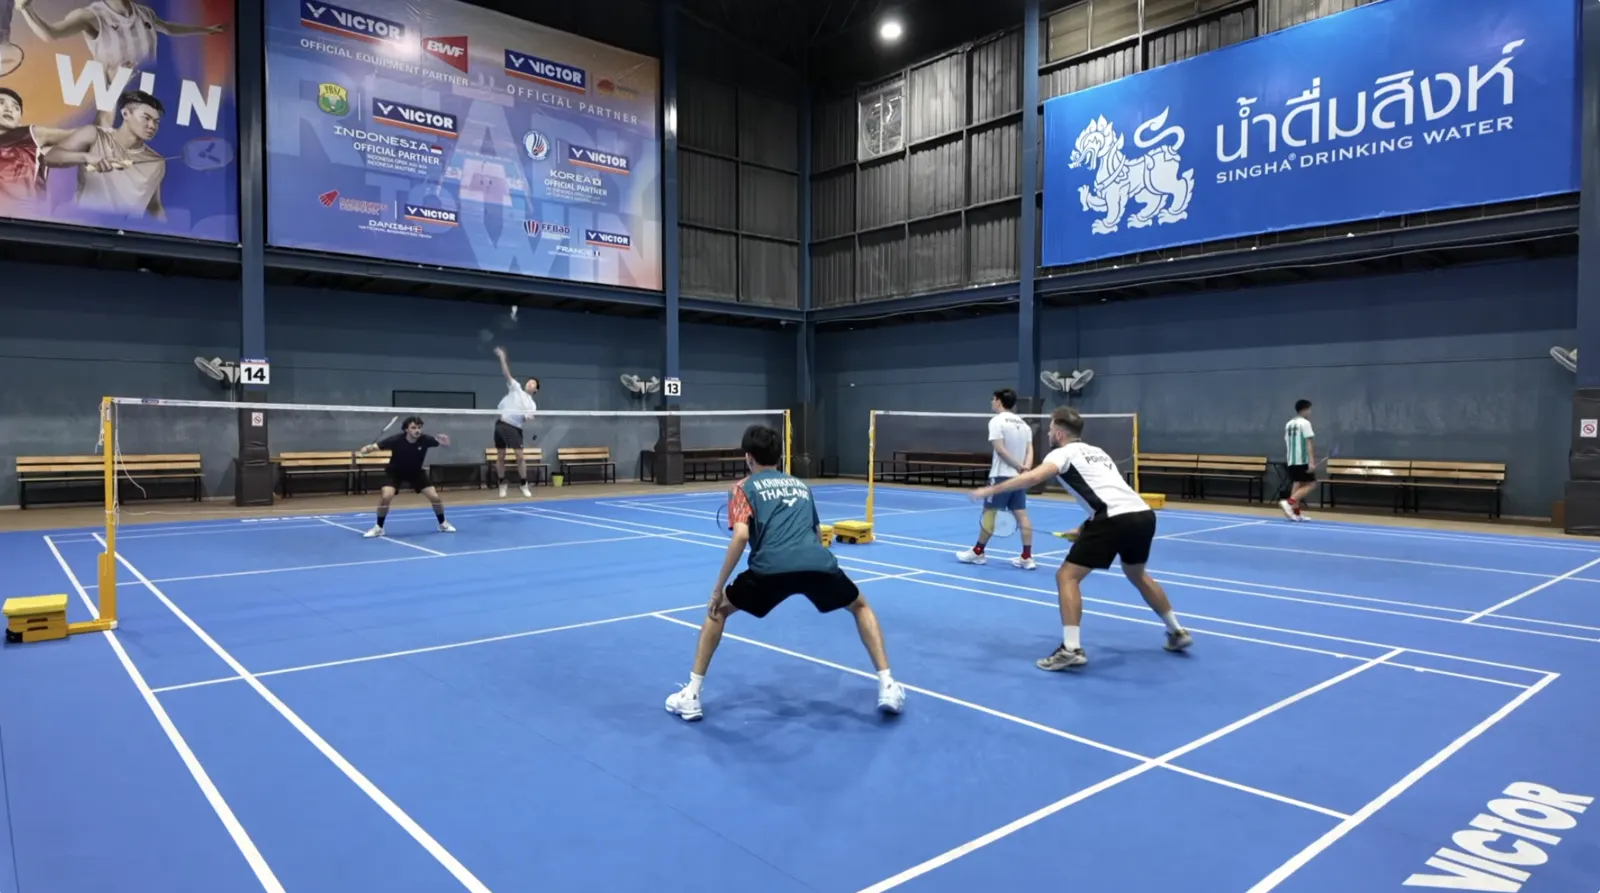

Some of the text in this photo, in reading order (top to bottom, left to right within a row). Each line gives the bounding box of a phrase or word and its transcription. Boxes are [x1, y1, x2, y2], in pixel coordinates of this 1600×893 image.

[331, 9, 402, 40] VICTOR
[427, 40, 465, 57] BWF
[300, 38, 469, 87] OFFICIAL EQUIPMENT PARTNER
[528, 59, 583, 84] VICTOR
[506, 84, 638, 125] OFFICIAL PARTNER
[1216, 38, 1525, 163] น้ำดื่มสิงห์
[398, 107, 453, 130] VICTOR
[333, 125, 430, 152] INDONESIA
[1300, 136, 1413, 169] DRINKING
[1423, 116, 1514, 145] WATER
[353, 141, 396, 158] OFFICIAL
[398, 150, 440, 166] PARTNER
[586, 150, 627, 168] VICTOR
[544, 178, 576, 191] OFFICIAL
[576, 185, 608, 196] PARTNER
[550, 169, 592, 184] KOREA
[420, 207, 456, 221] VICTOR
[368, 220, 413, 232] DANISH
[599, 234, 629, 245] VICTOR
[244, 366, 266, 382] 14
[667, 383, 679, 394] 13
[1401, 781, 1595, 893] VICTOR
